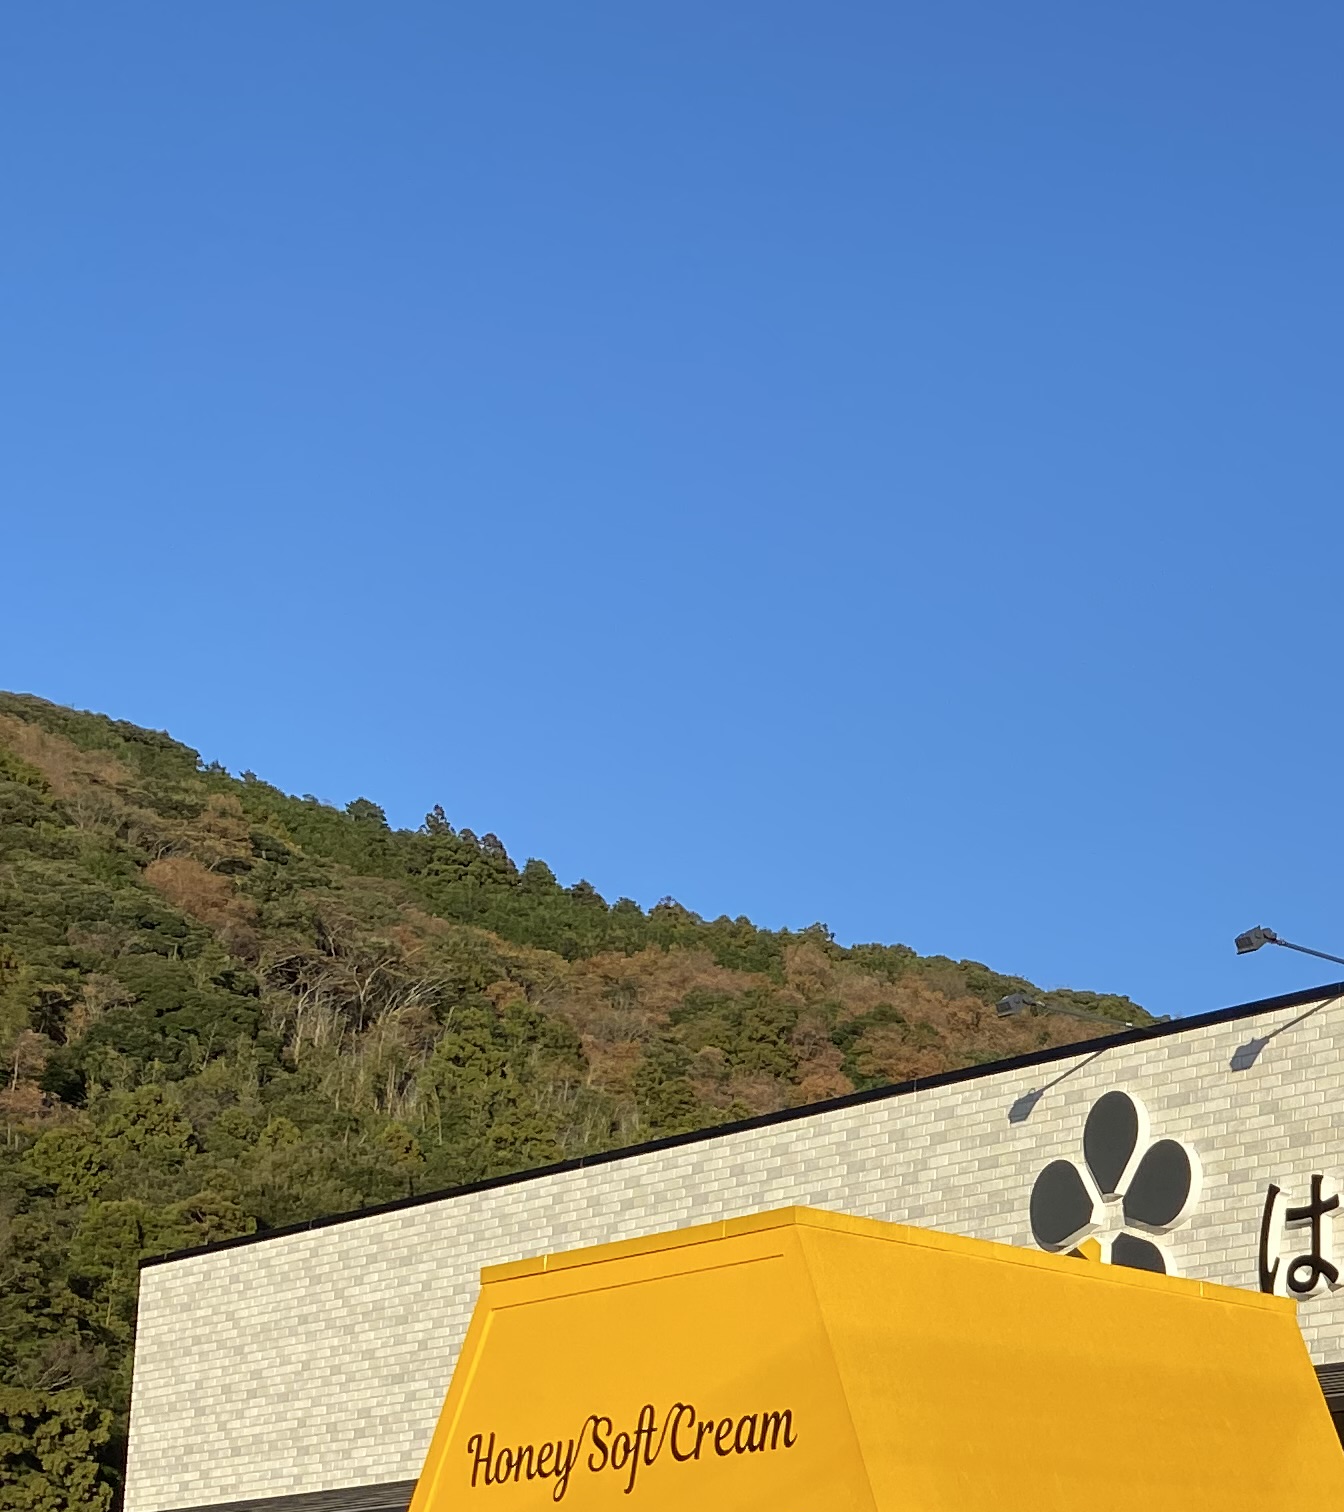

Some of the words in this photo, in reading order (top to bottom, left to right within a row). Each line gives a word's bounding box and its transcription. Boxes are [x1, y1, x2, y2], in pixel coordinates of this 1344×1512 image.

[467, 1431, 575, 1503] Honey
[580, 1403, 660, 1495] Soft
[667, 1402, 799, 1463] Cream
